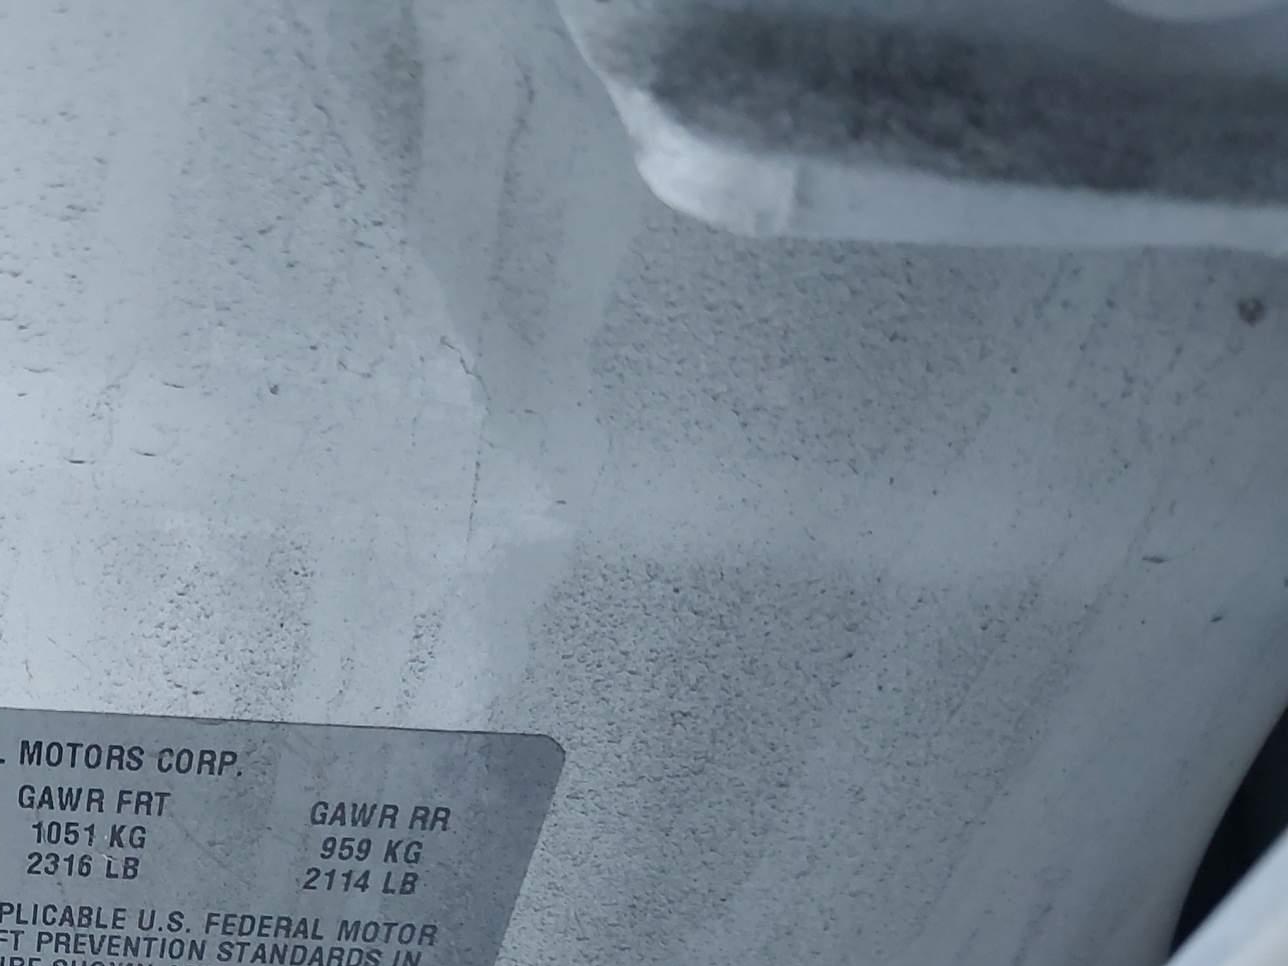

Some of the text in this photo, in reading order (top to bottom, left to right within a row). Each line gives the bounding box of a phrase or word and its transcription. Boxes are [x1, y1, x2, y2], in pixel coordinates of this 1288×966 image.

[19, 740, 145, 772] MOTORS
[158, 748, 244, 778] CORP.
[17, 785, 172, 817] GAWR FRT
[310, 801, 452, 832] GAWR RR
[31, 822, 147, 849] 1051 KG
[26, 852, 140, 881] 2316 LB
[320, 838, 423, 865] 959 KG
[302, 868, 417, 896] 2114 LB
[137, 909, 193, 934] U.S.
[205, 912, 324, 941] FEDERAL
[336, 919, 438, 946] MOTOR
[35, 932, 207, 962] PREVENTION
